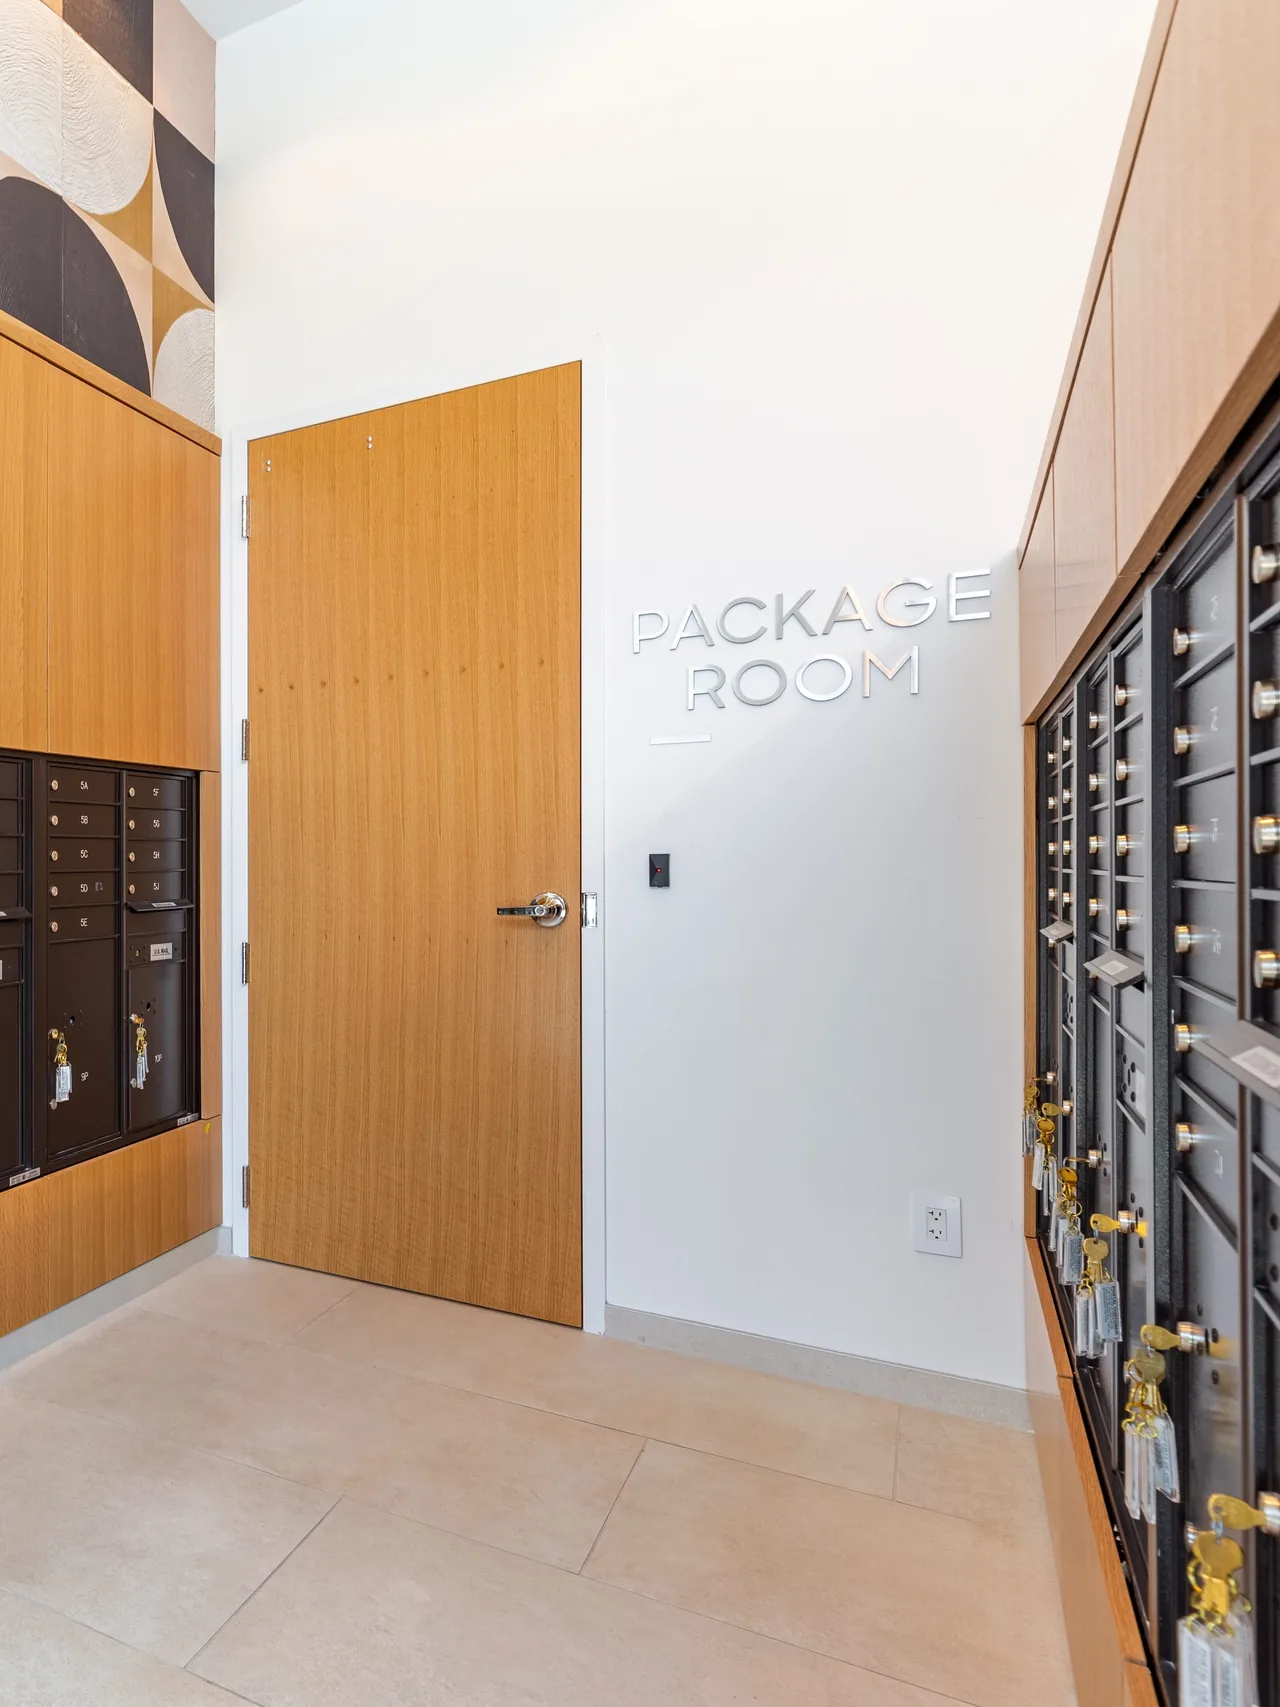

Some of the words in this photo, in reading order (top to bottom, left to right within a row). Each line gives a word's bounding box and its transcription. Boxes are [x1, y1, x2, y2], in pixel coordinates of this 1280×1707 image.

[633, 567, 991, 654] PACKAGE
[686, 644, 919, 711] ROOM
[80, 780, 89, 790] 5A
[80, 815, 89, 825] 5B
[80, 849, 89, 859] 5C
[80, 883, 89, 893] 5D
[80, 917, 88, 927] 5E
